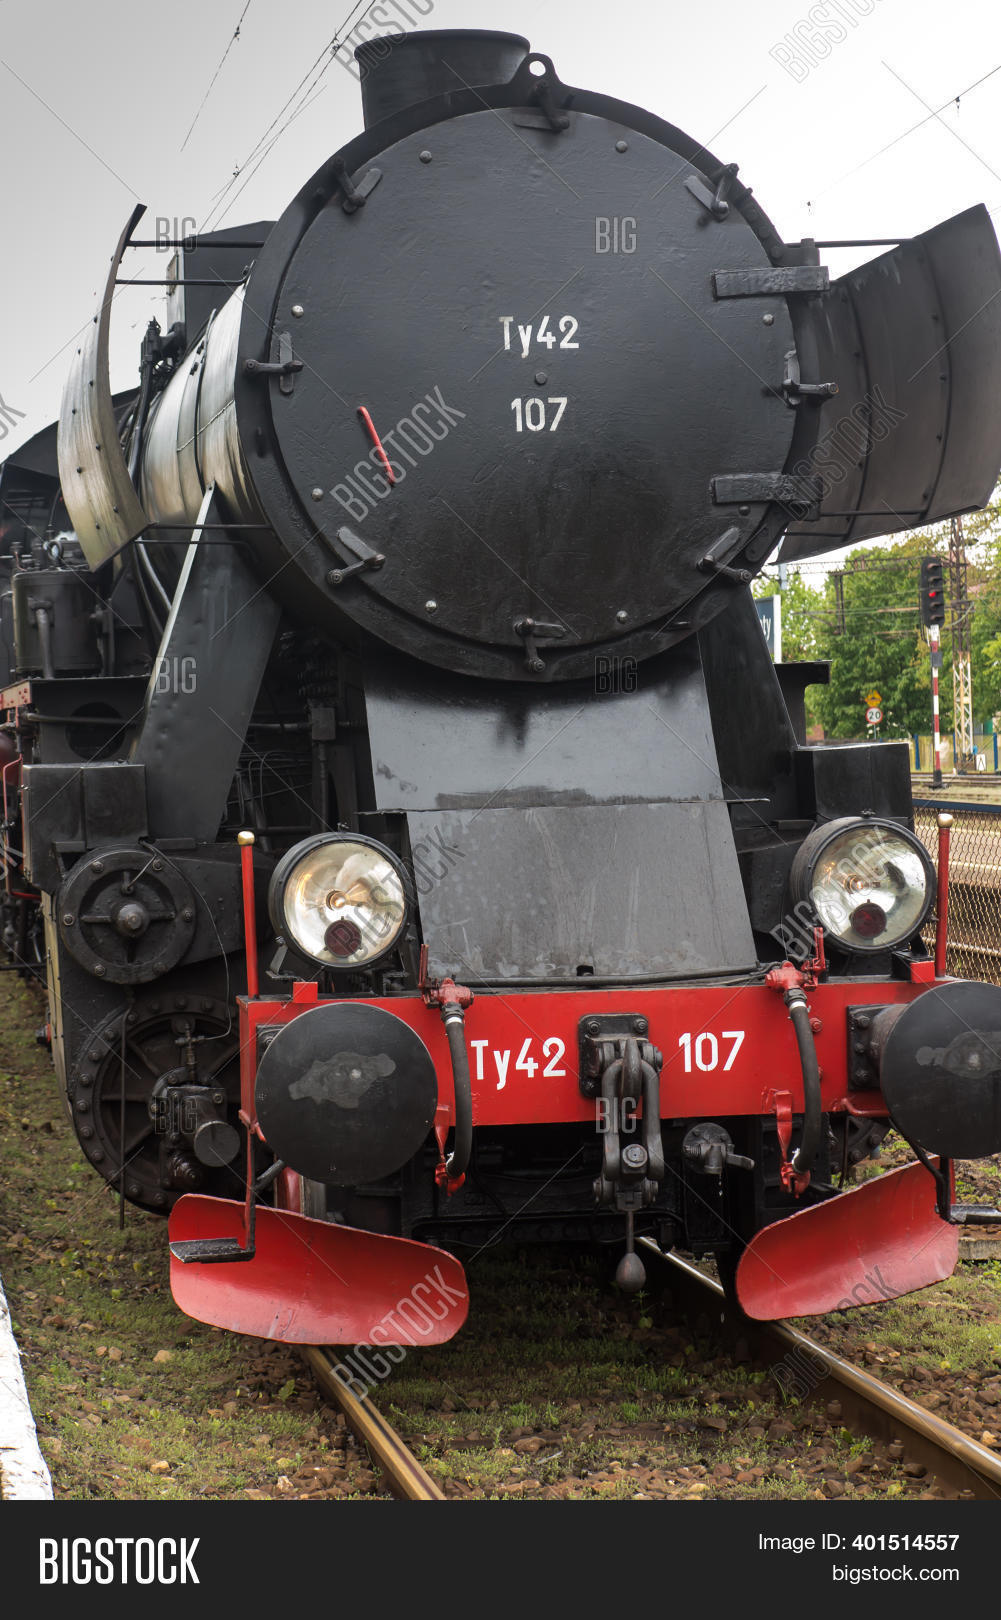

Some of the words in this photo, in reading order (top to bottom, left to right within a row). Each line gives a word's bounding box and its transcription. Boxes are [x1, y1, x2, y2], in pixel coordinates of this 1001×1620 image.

[499, 315, 580, 359] Ty42
[511, 397, 568, 432] 107
[760, 614, 772, 641] ty
[868, 711, 881, 720] 20
[470, 1037, 567, 1091] Ty42
[678, 1030, 746, 1073] 107
